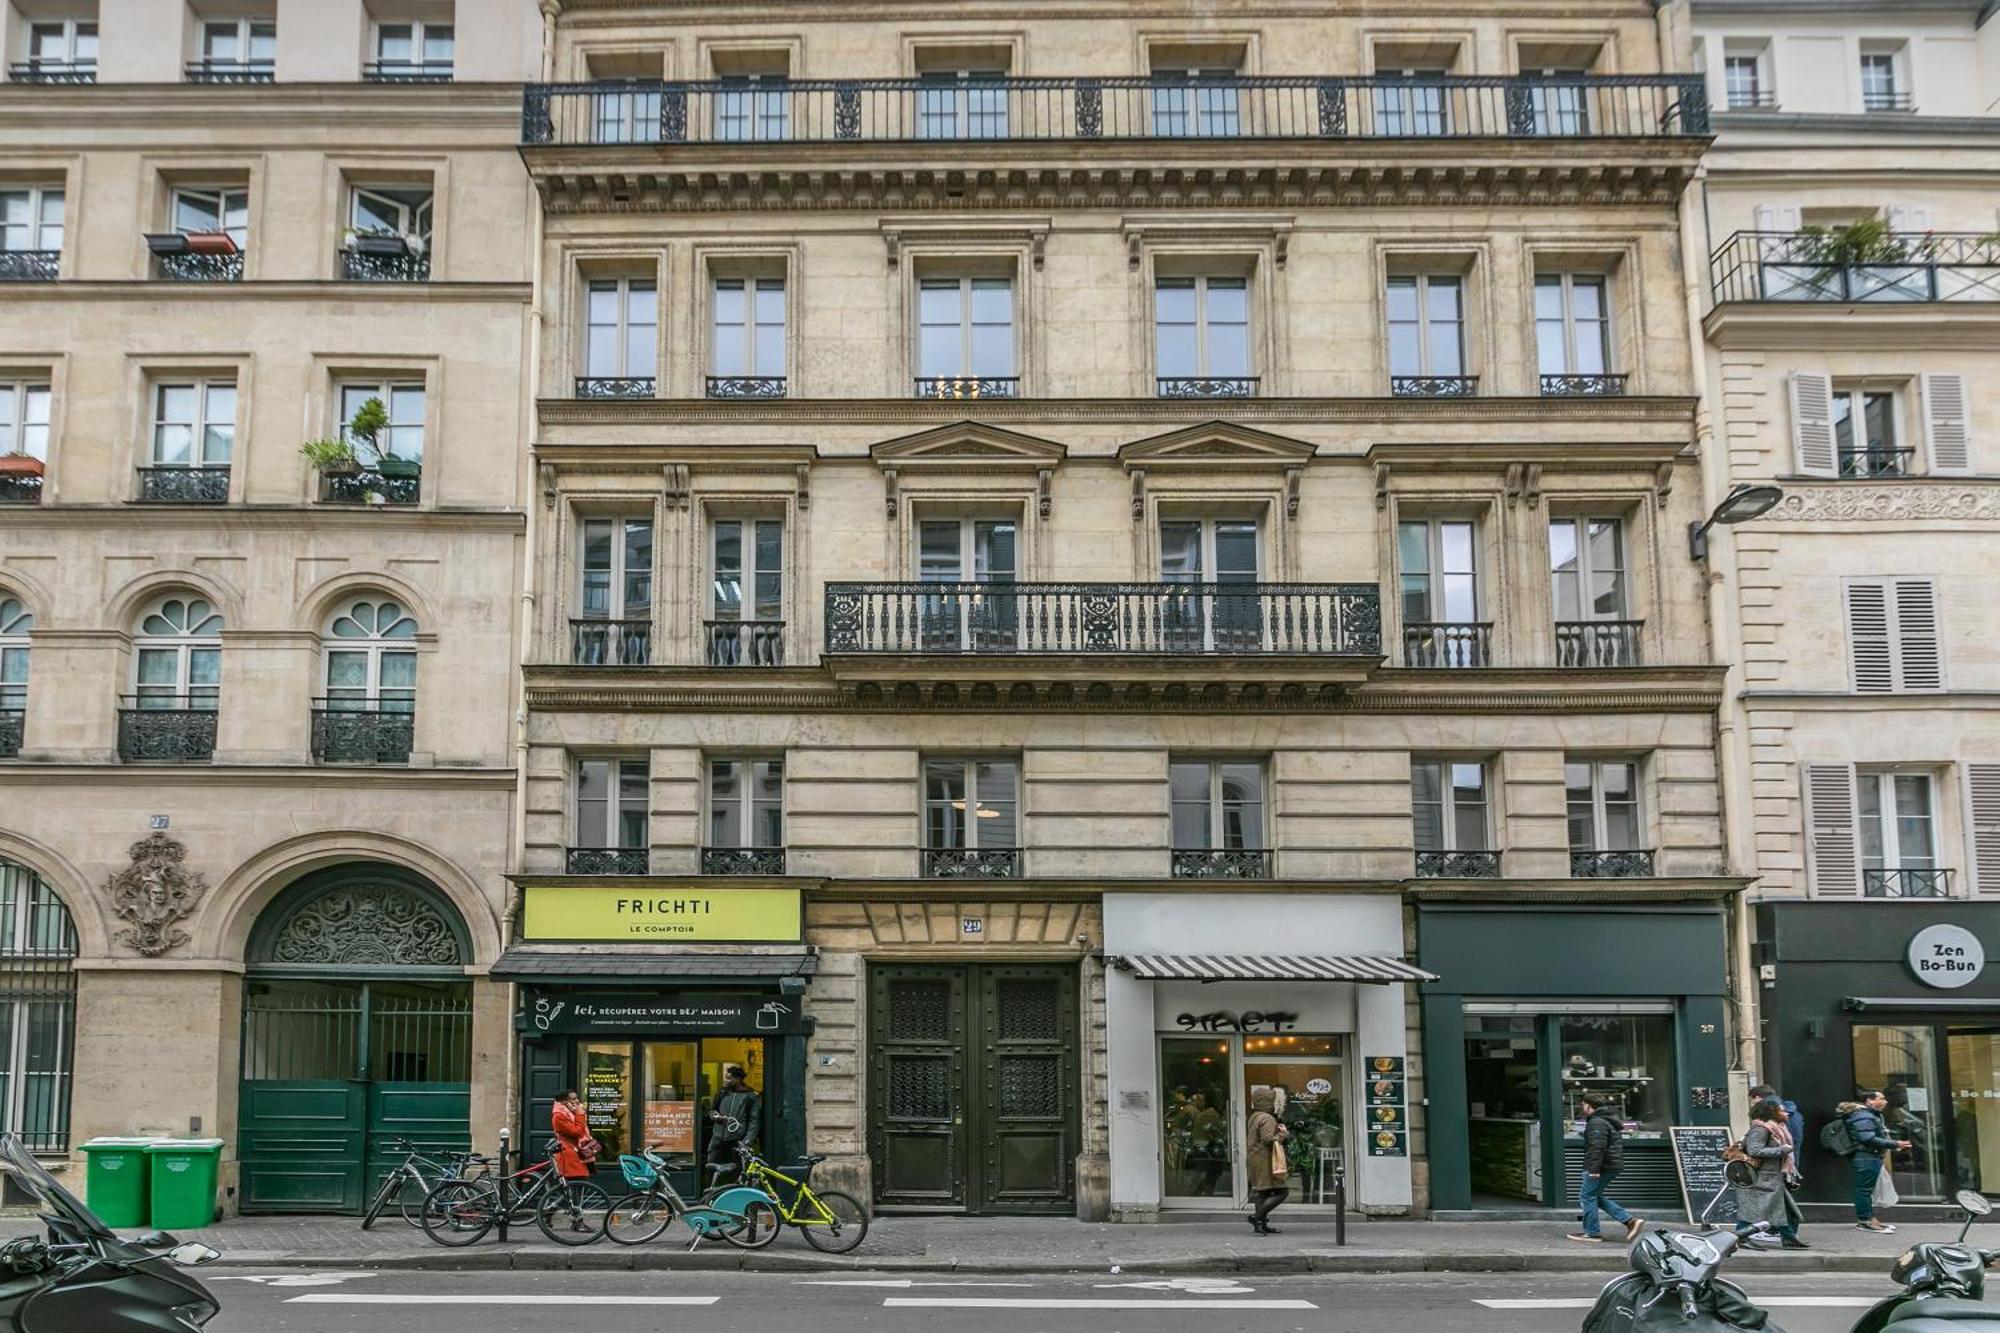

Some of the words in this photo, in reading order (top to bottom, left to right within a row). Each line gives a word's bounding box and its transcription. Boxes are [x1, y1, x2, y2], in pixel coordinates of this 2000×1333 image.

[151, 815, 169, 829] 27
[617, 900, 709, 913] FRICHTI
[964, 920, 981, 932] 29
[1933, 944, 1964, 956] Zen
[1920, 959, 1976, 971] Bo-Bun
[575, 1005, 597, 1016] Ici,
[599, 1007, 647, 1016] RÉCUPÉREZ
[650, 1008, 677, 1016] VOTRE
[701, 1008, 735, 1016] MAISON
